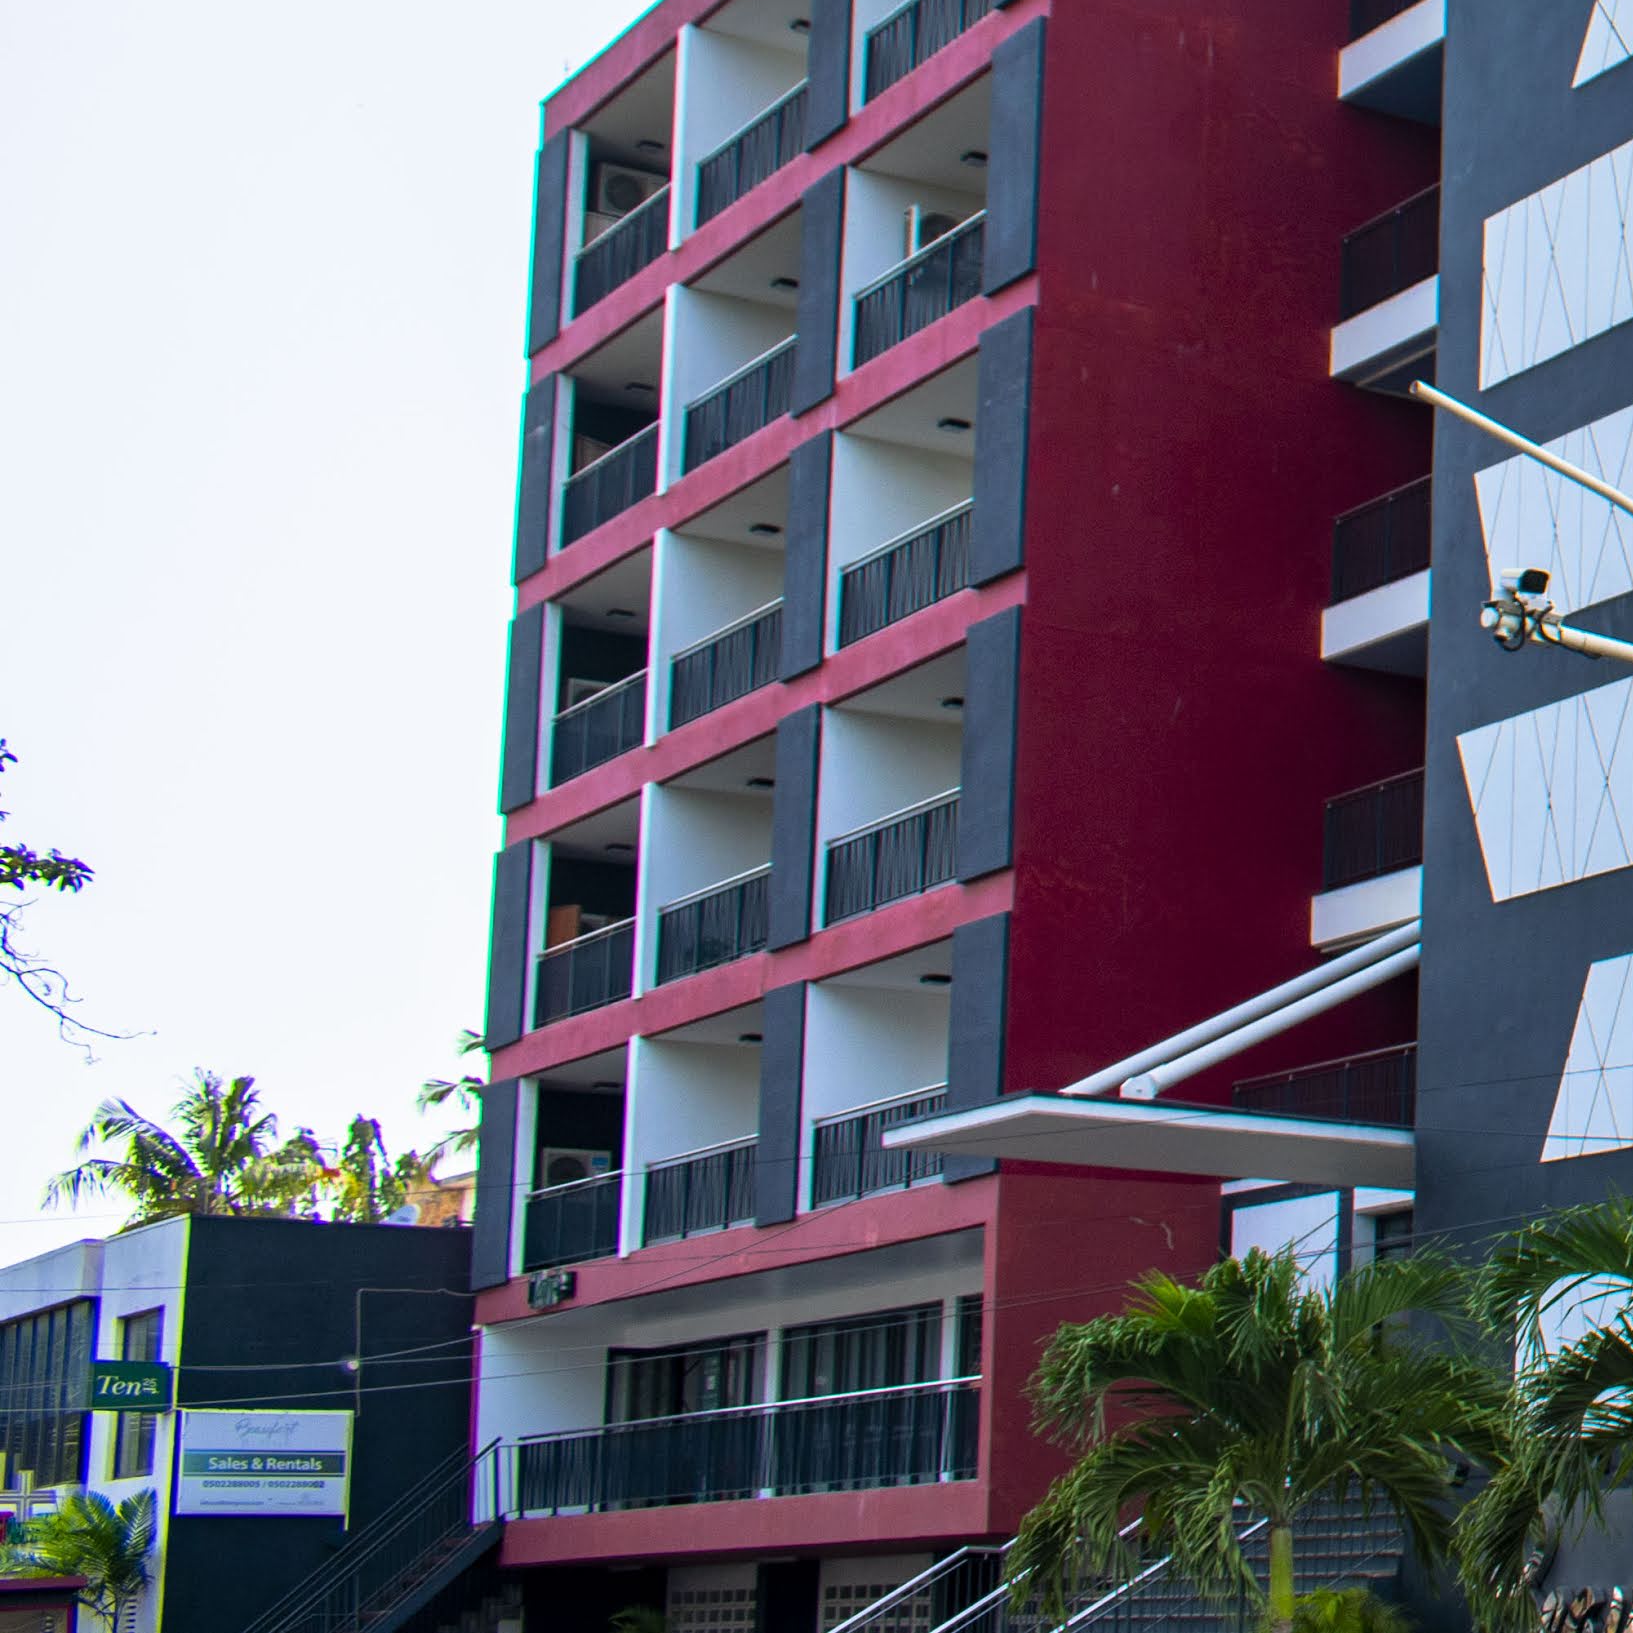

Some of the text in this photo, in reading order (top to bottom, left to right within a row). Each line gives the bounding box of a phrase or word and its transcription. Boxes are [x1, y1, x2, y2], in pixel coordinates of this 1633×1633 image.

[208, 1457, 323, 1471] Sales & Rentals
